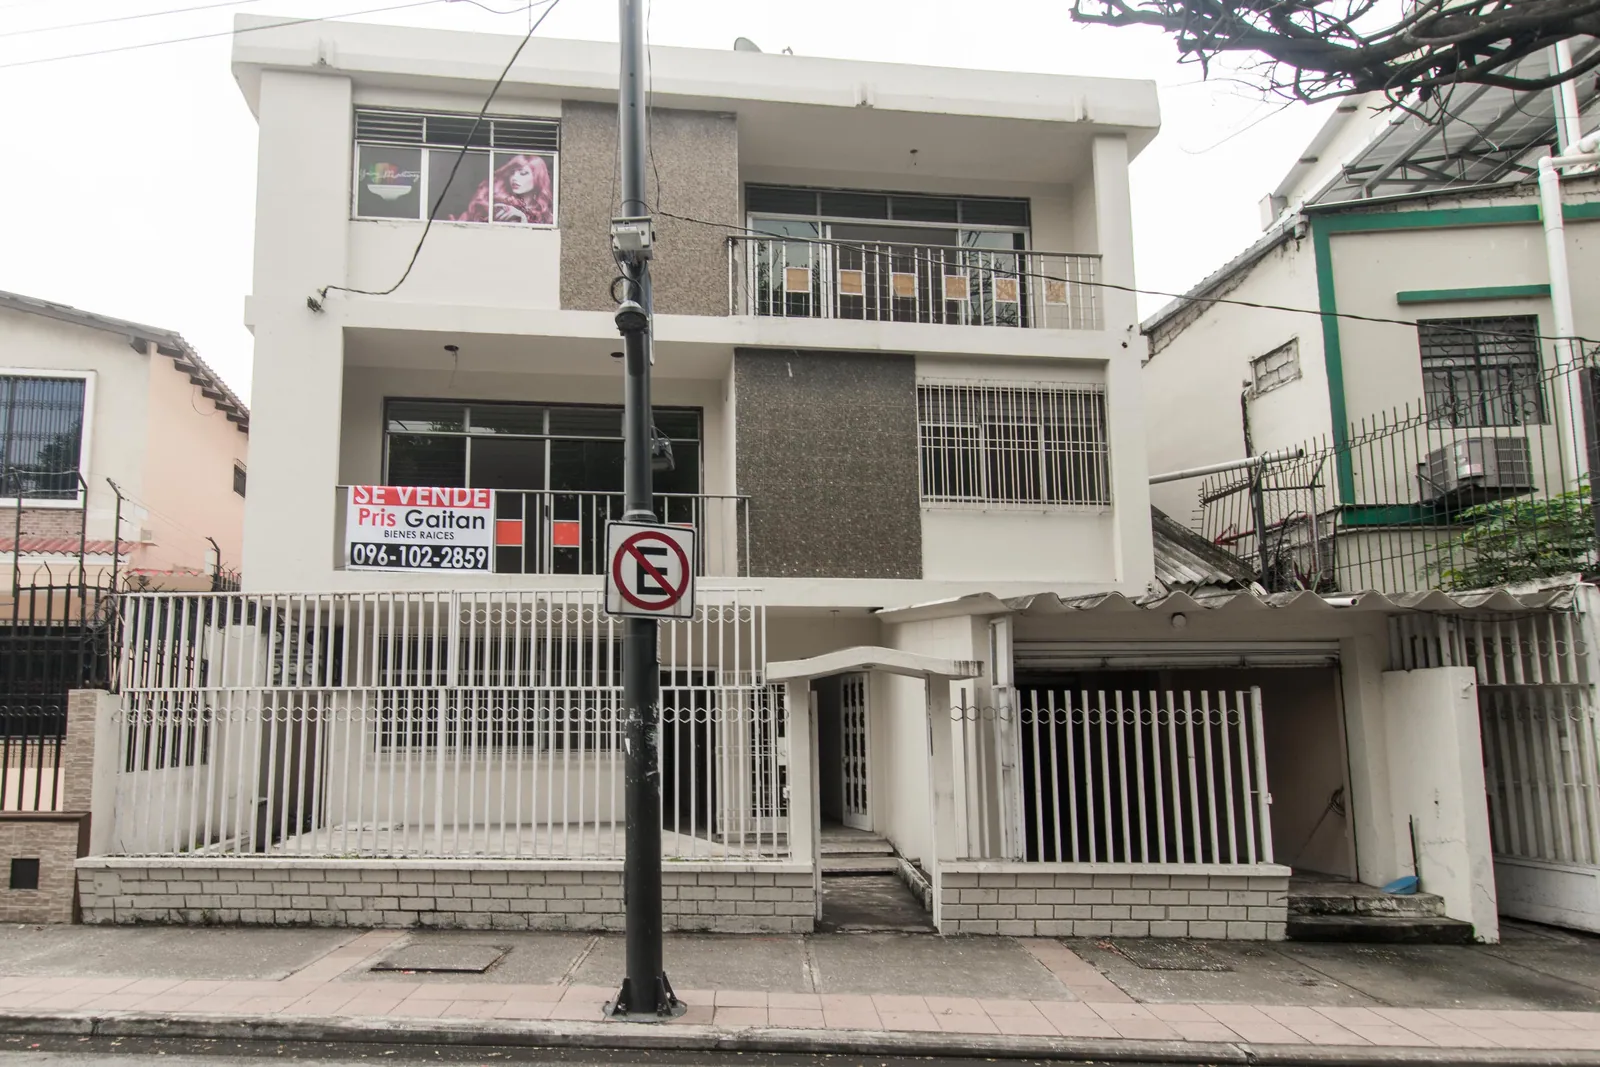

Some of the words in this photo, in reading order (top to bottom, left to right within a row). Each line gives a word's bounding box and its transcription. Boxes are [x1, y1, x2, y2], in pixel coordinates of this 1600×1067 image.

[355, 487, 386, 504] SE
[396, 487, 487, 508] VENDE
[358, 508, 396, 527] Pris
[405, 509, 485, 529] Gaitan
[384, 530, 417, 539] BIENES
[419, 531, 455, 540] RAICES
[353, 544, 486, 568] 096-102-2859
[636, 546, 668, 595] E
